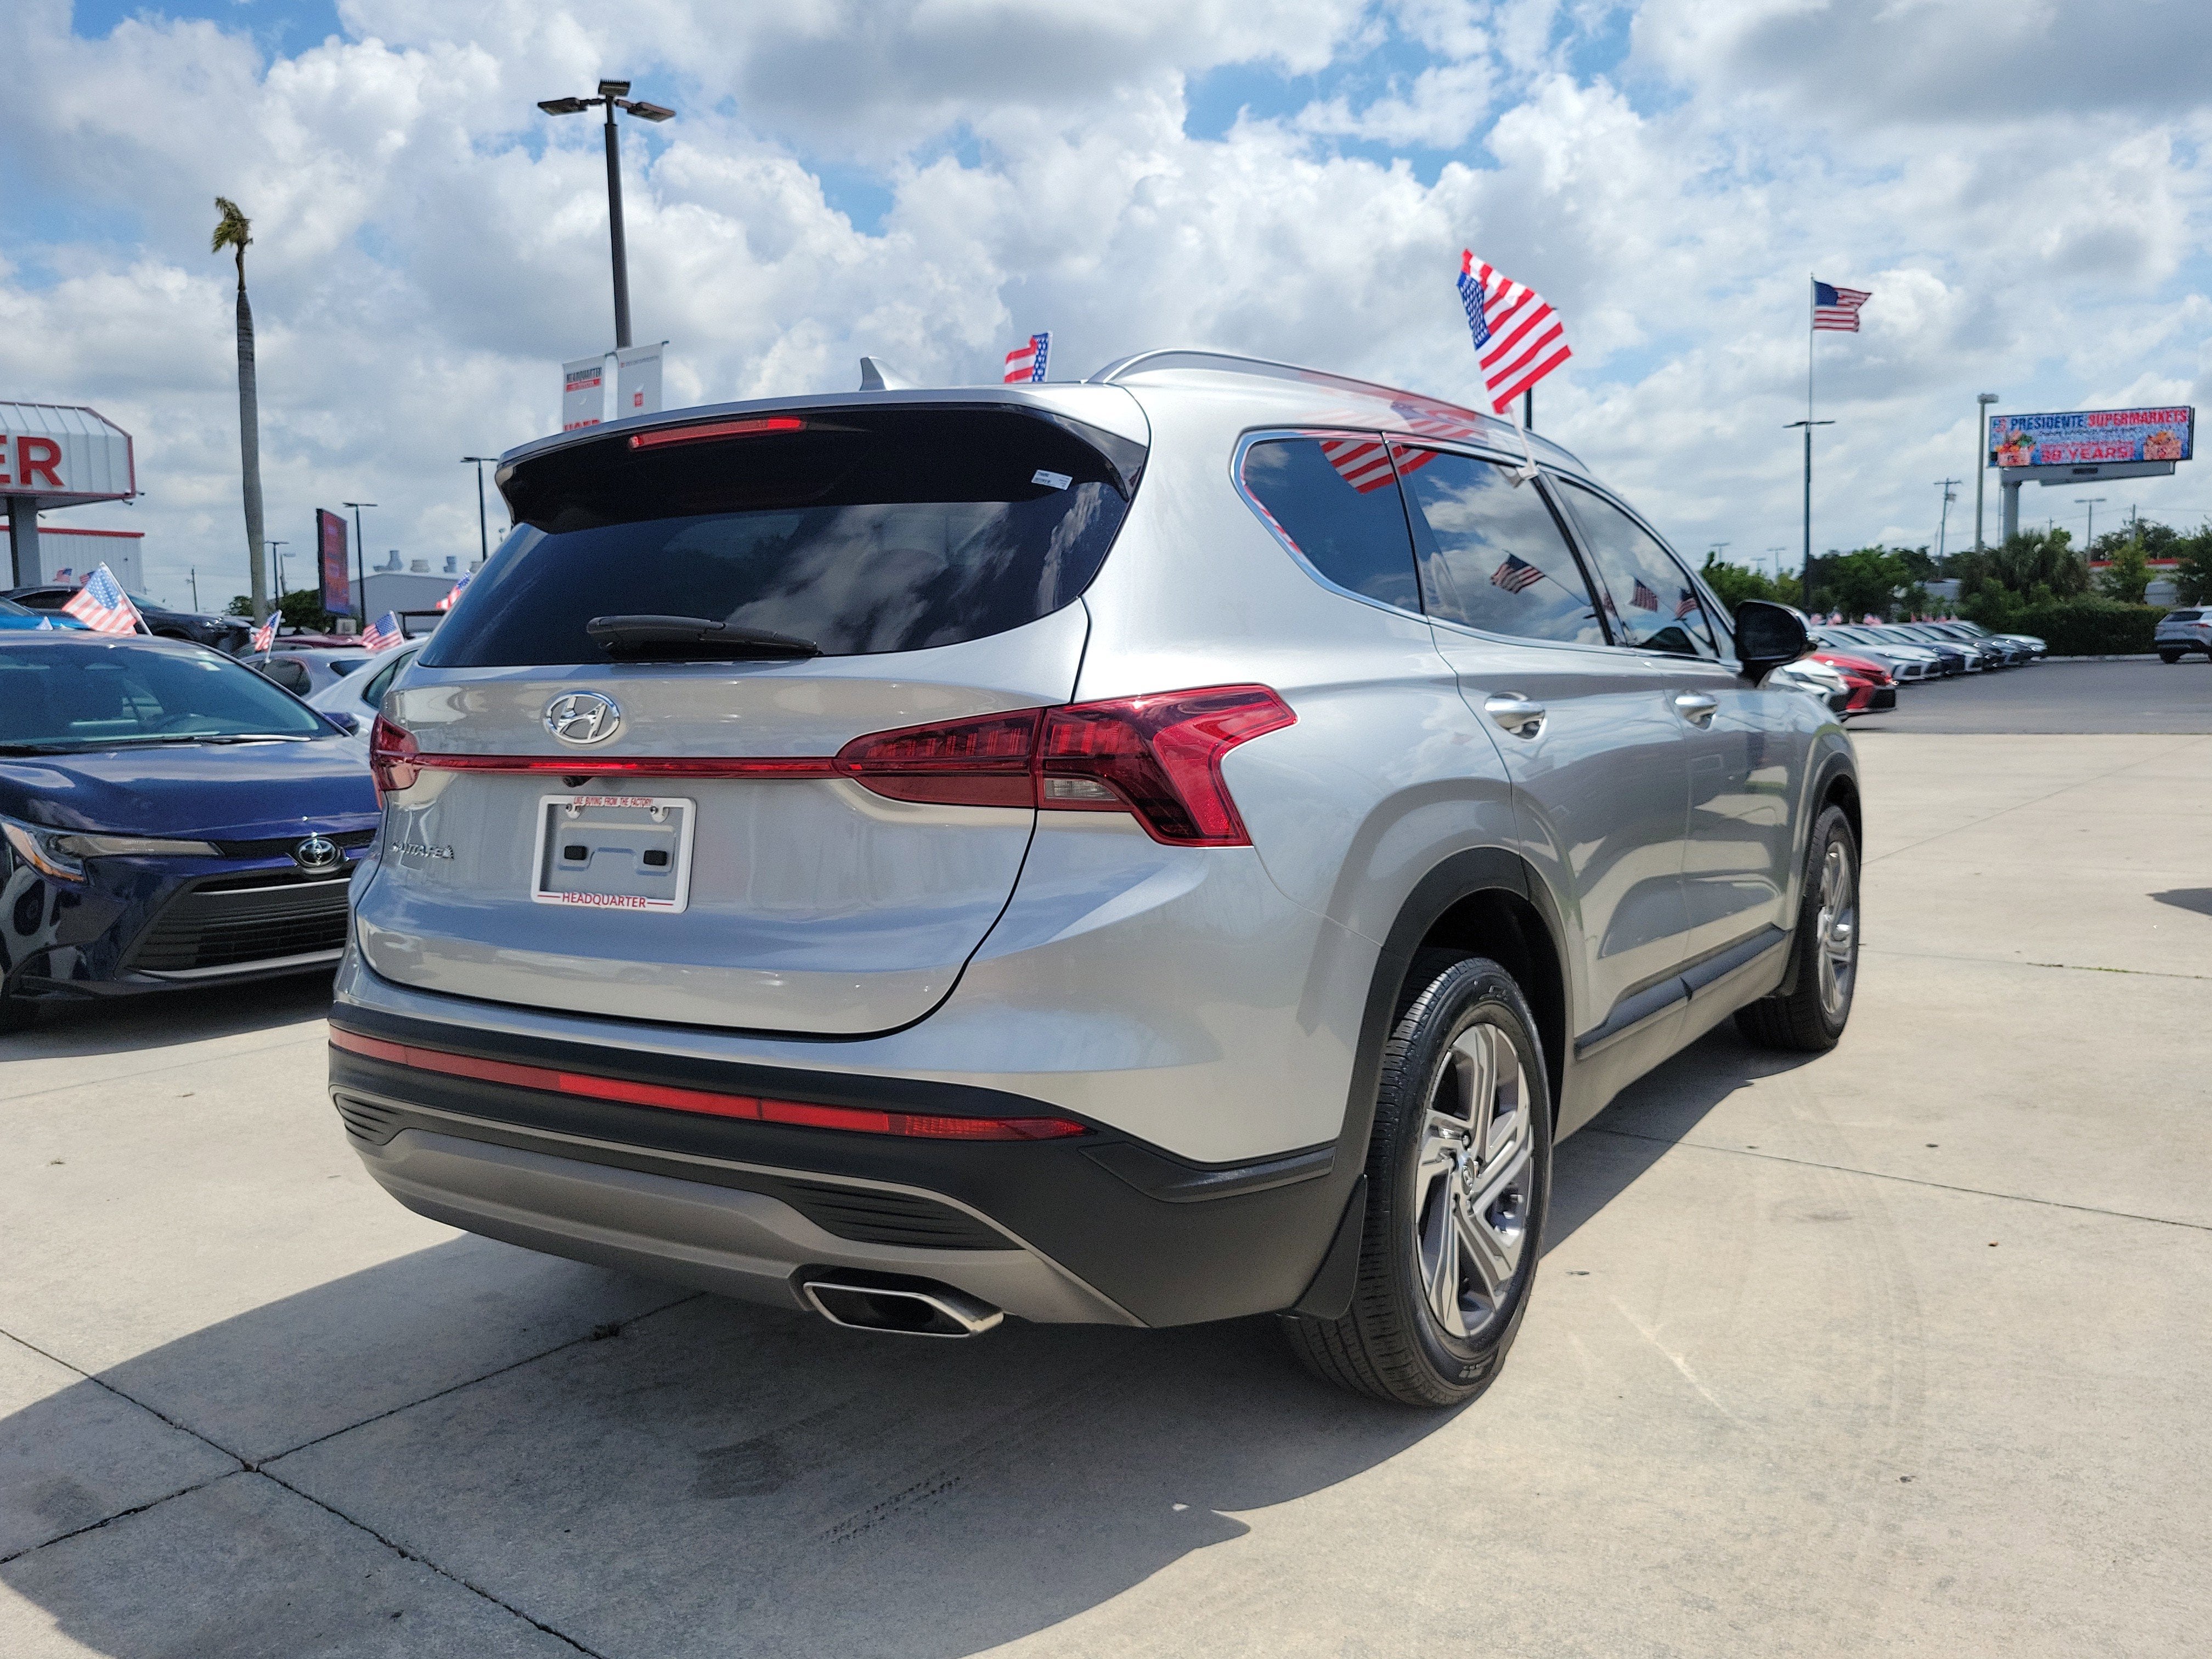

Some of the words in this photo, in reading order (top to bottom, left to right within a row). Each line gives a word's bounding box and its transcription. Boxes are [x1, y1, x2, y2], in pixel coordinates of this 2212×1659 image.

[2011, 415, 2084, 430] PRESIDENTE
[2088, 409, 2187, 427] SUPERMARKETS
[0, 435, 64, 486] R
[2067, 447, 2134, 460] YEARS!
[585, 797, 602, 805] BUYING
[620, 798, 629, 806] THE
[562, 893, 646, 907] HEADQUARTER
